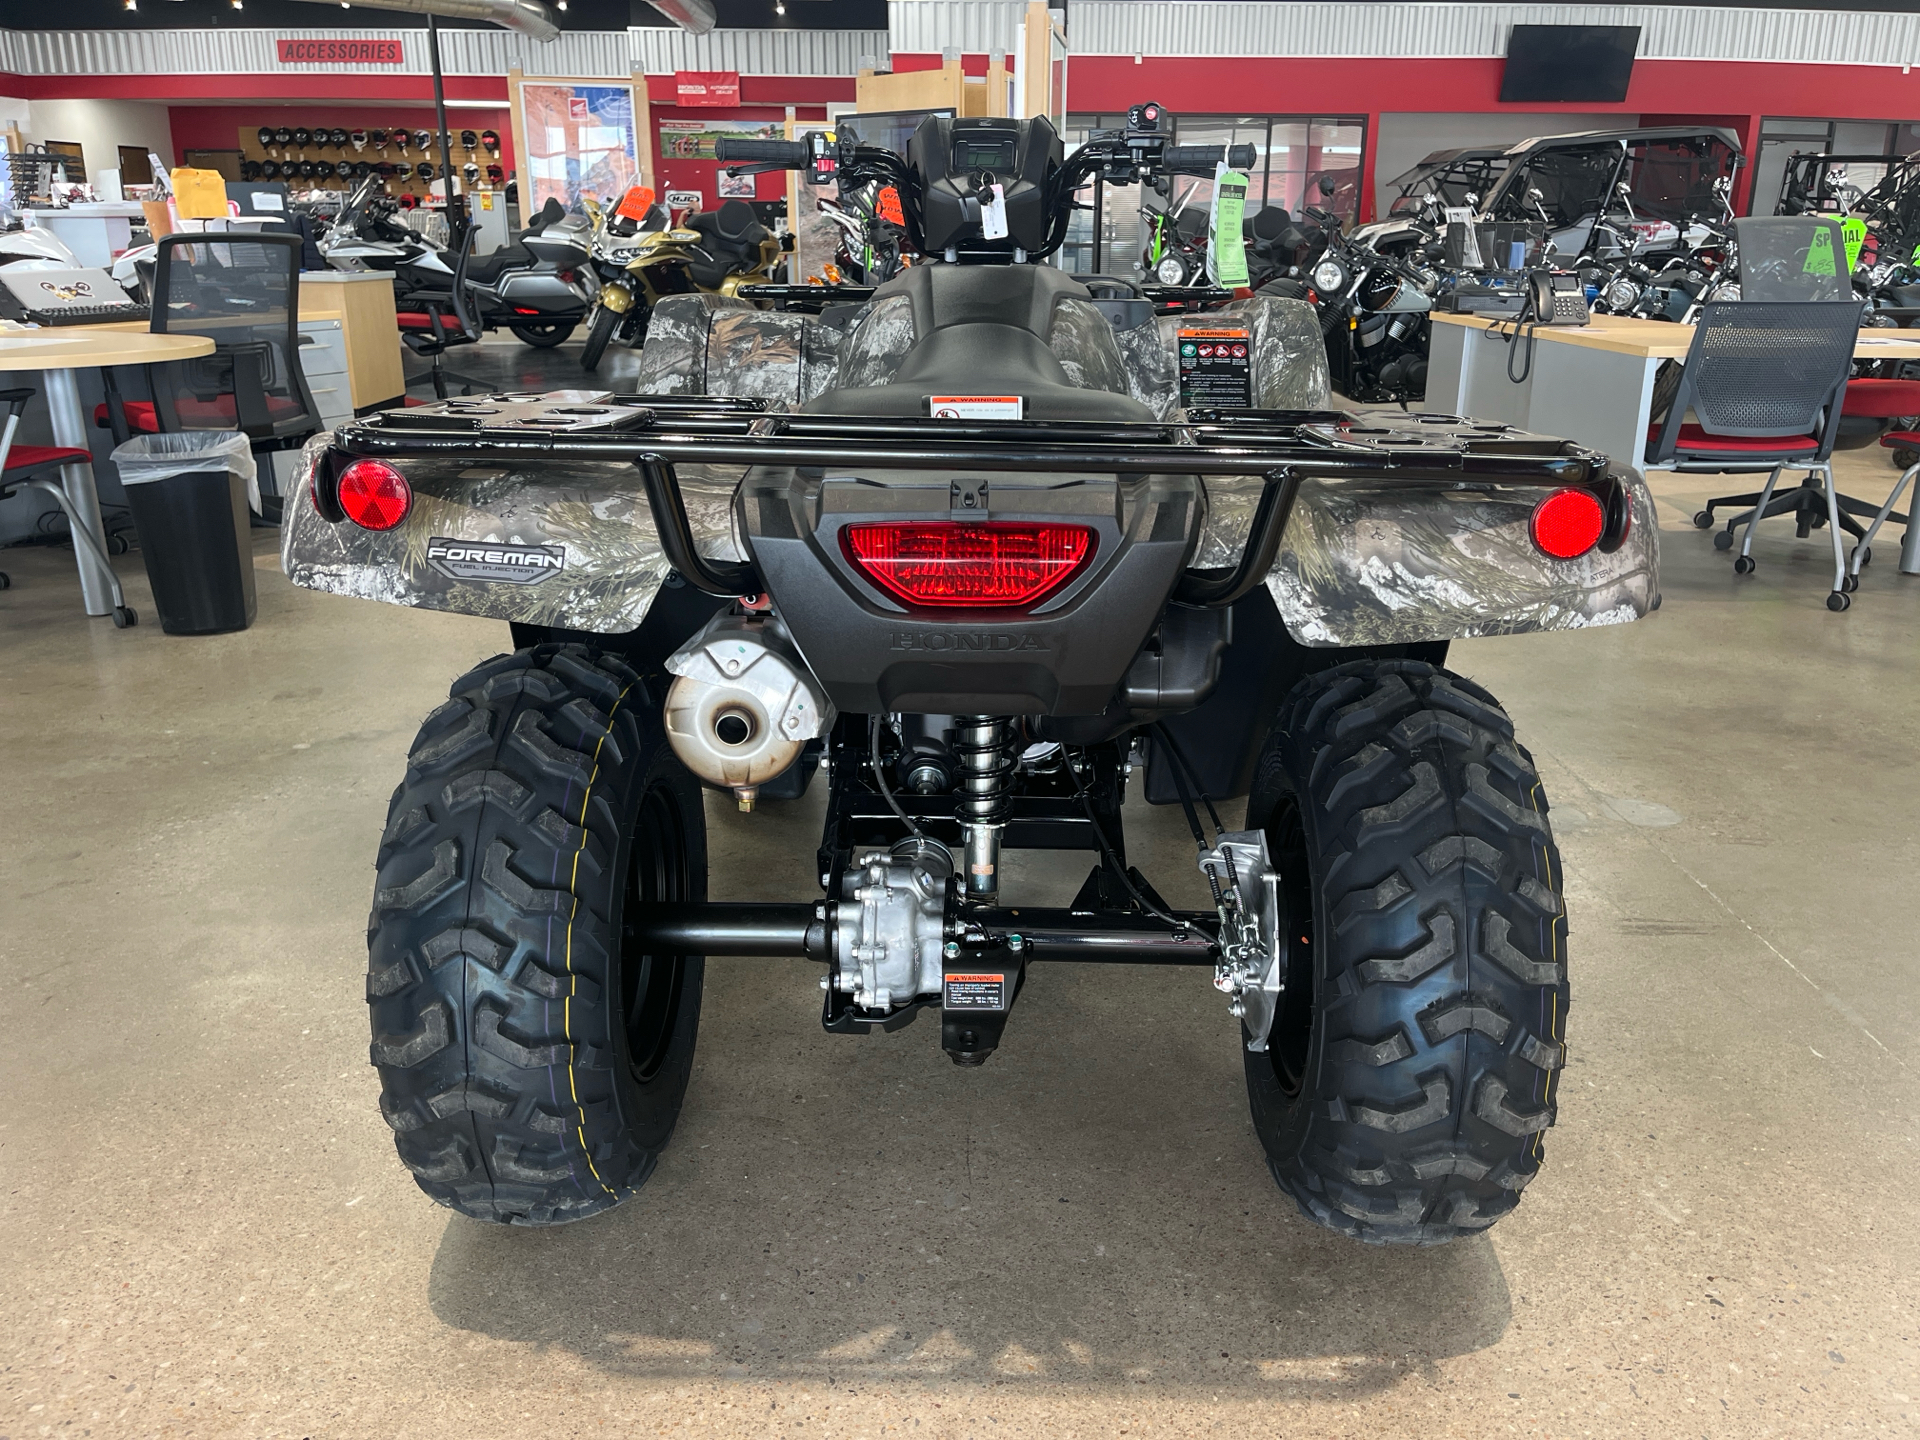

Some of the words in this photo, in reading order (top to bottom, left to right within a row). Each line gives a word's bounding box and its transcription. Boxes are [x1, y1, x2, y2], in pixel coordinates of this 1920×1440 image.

[284, 43, 396, 59] ACCESSORIES
[1816, 229, 1860, 248] SPIAL
[428, 547, 563, 568] FOREMAN
[452, 563, 480, 571] FUEL
[482, 565, 534, 574] INJECTION
[1590, 567, 1614, 582] ATERA
[889, 632, 1051, 652] HONDA
